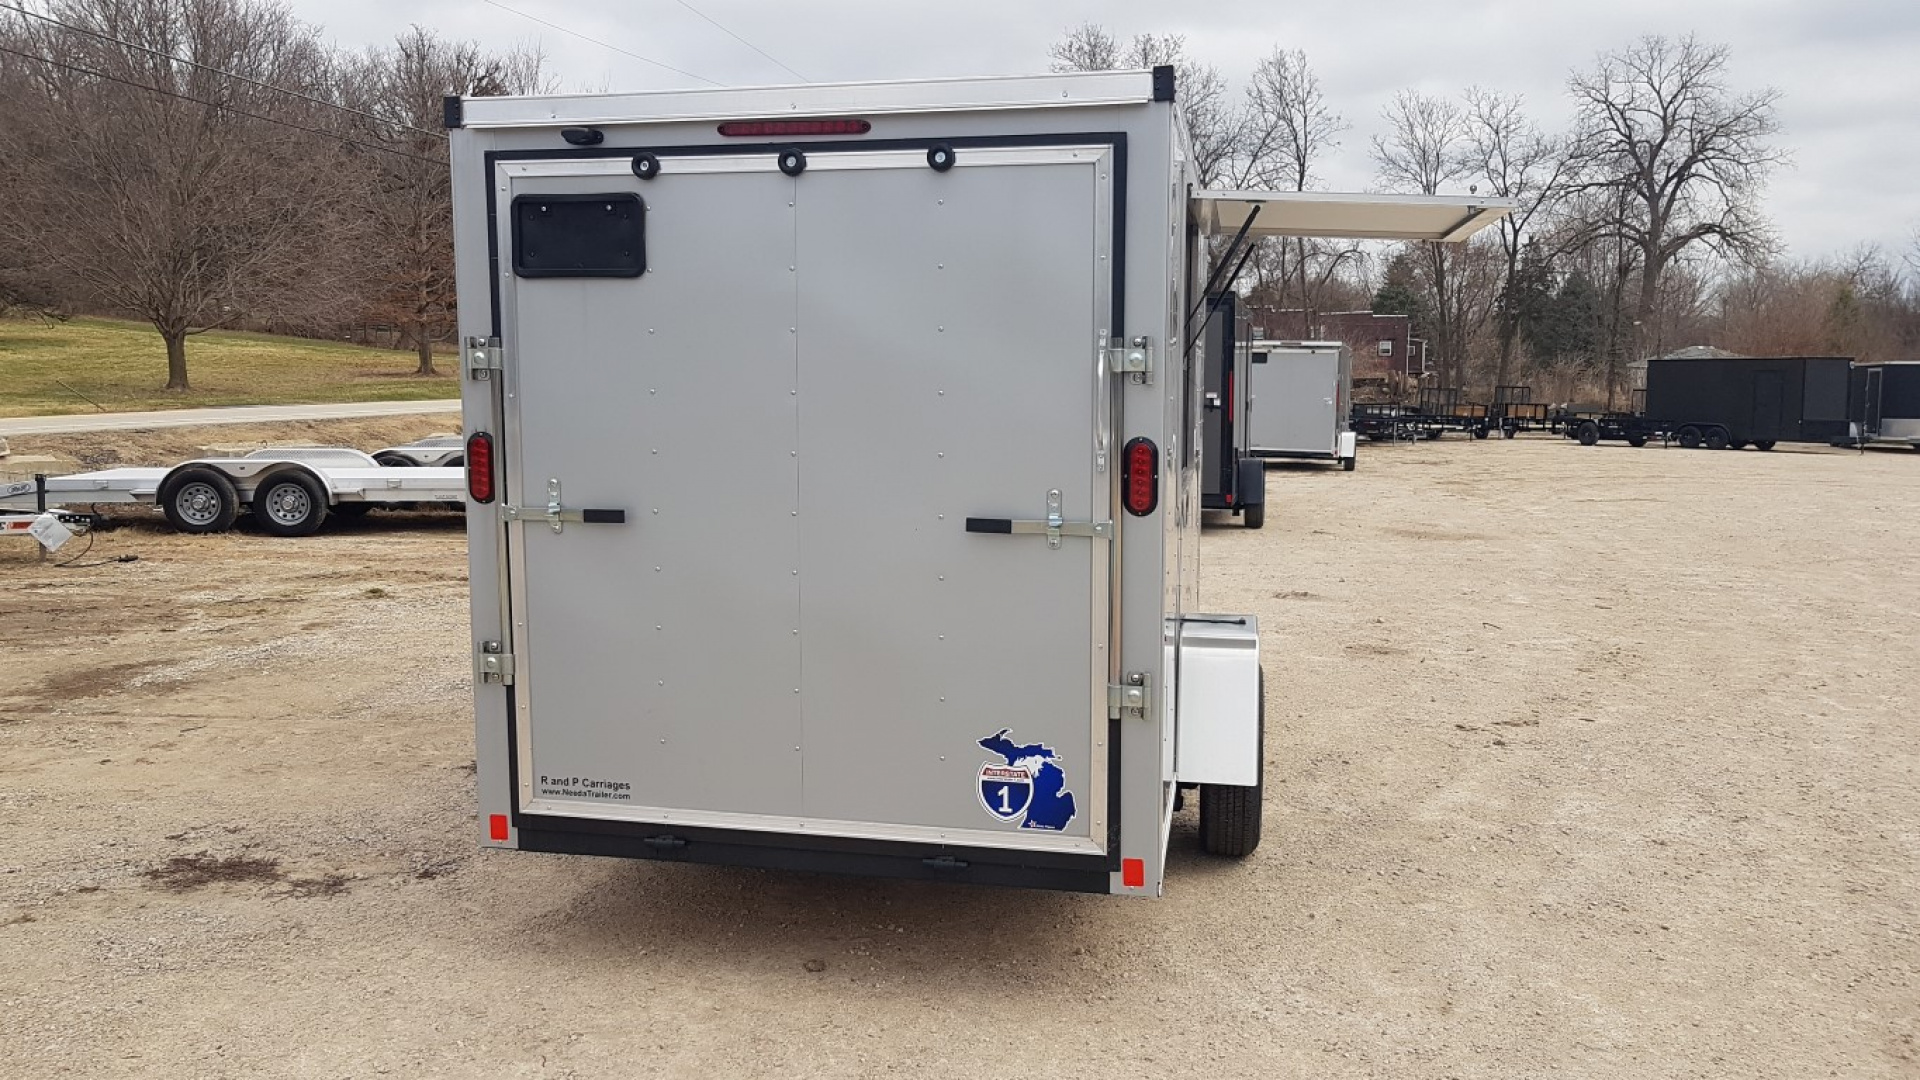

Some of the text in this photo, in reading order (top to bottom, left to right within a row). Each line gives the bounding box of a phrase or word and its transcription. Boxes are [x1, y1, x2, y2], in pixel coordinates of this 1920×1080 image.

[986, 769, 1024, 778] INTERSTATE
[541, 776, 631, 791] R and P Carriages
[541, 788, 631, 800] www.NeedaTrailer.com
[998, 786, 1013, 812] 1
